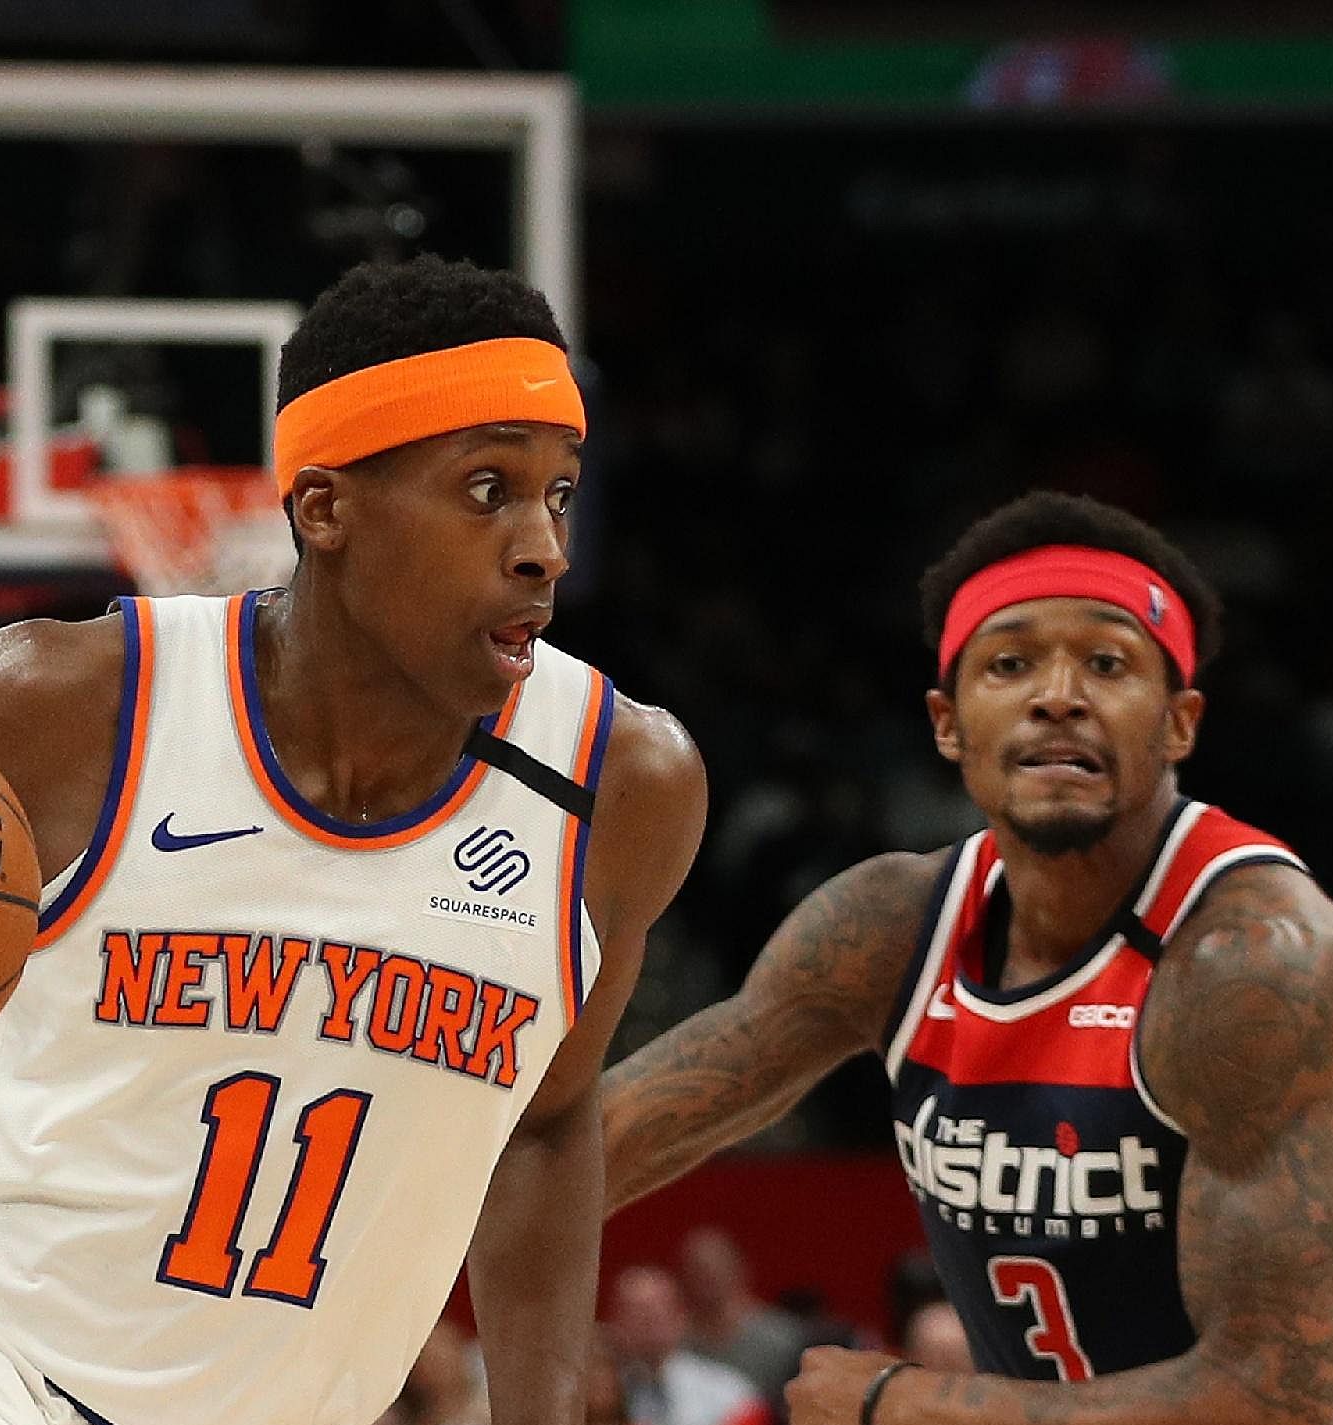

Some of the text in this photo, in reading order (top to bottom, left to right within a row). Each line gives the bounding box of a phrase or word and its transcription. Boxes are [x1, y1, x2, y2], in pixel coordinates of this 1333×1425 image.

[429, 895, 538, 928] SQUARESPACE
[94, 930, 542, 1090] NEW YORK
[156, 1070, 373, 1309] 11
[894, 1095, 1160, 1215] district
[937, 1116, 987, 1144] THE
[987, 1255, 1095, 1381] 3
